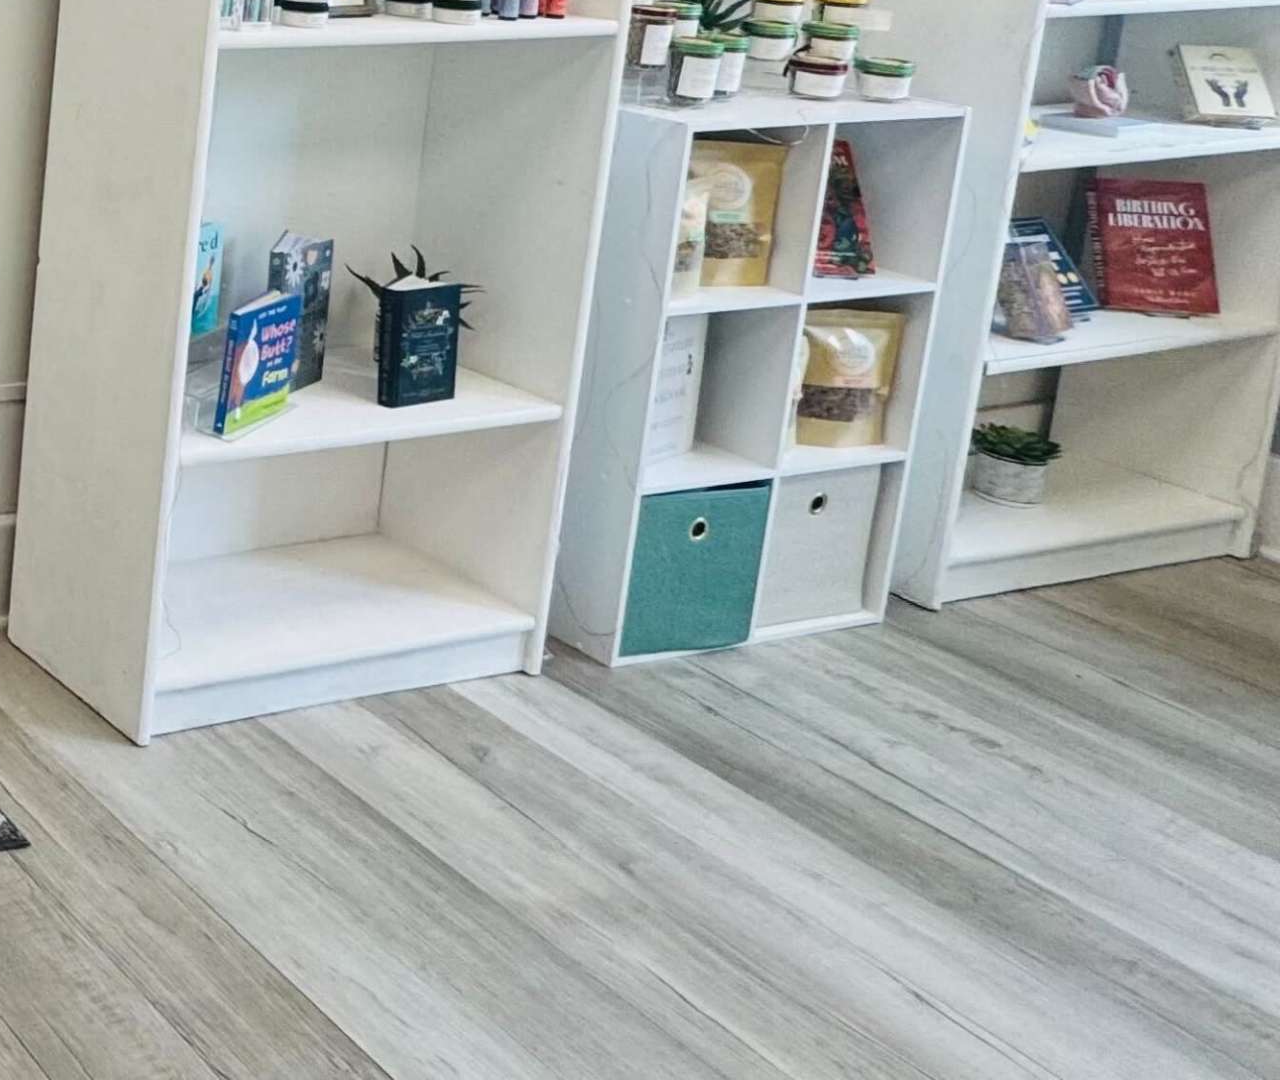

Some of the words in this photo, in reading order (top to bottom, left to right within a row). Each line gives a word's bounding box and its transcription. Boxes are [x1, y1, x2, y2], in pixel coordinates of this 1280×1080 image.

[1115, 198, 1196, 216] BIRTHING
[1107, 212, 1205, 231] LIBERATION
[261, 318, 296, 342] Whose
[261, 336, 293, 361] Butt?
